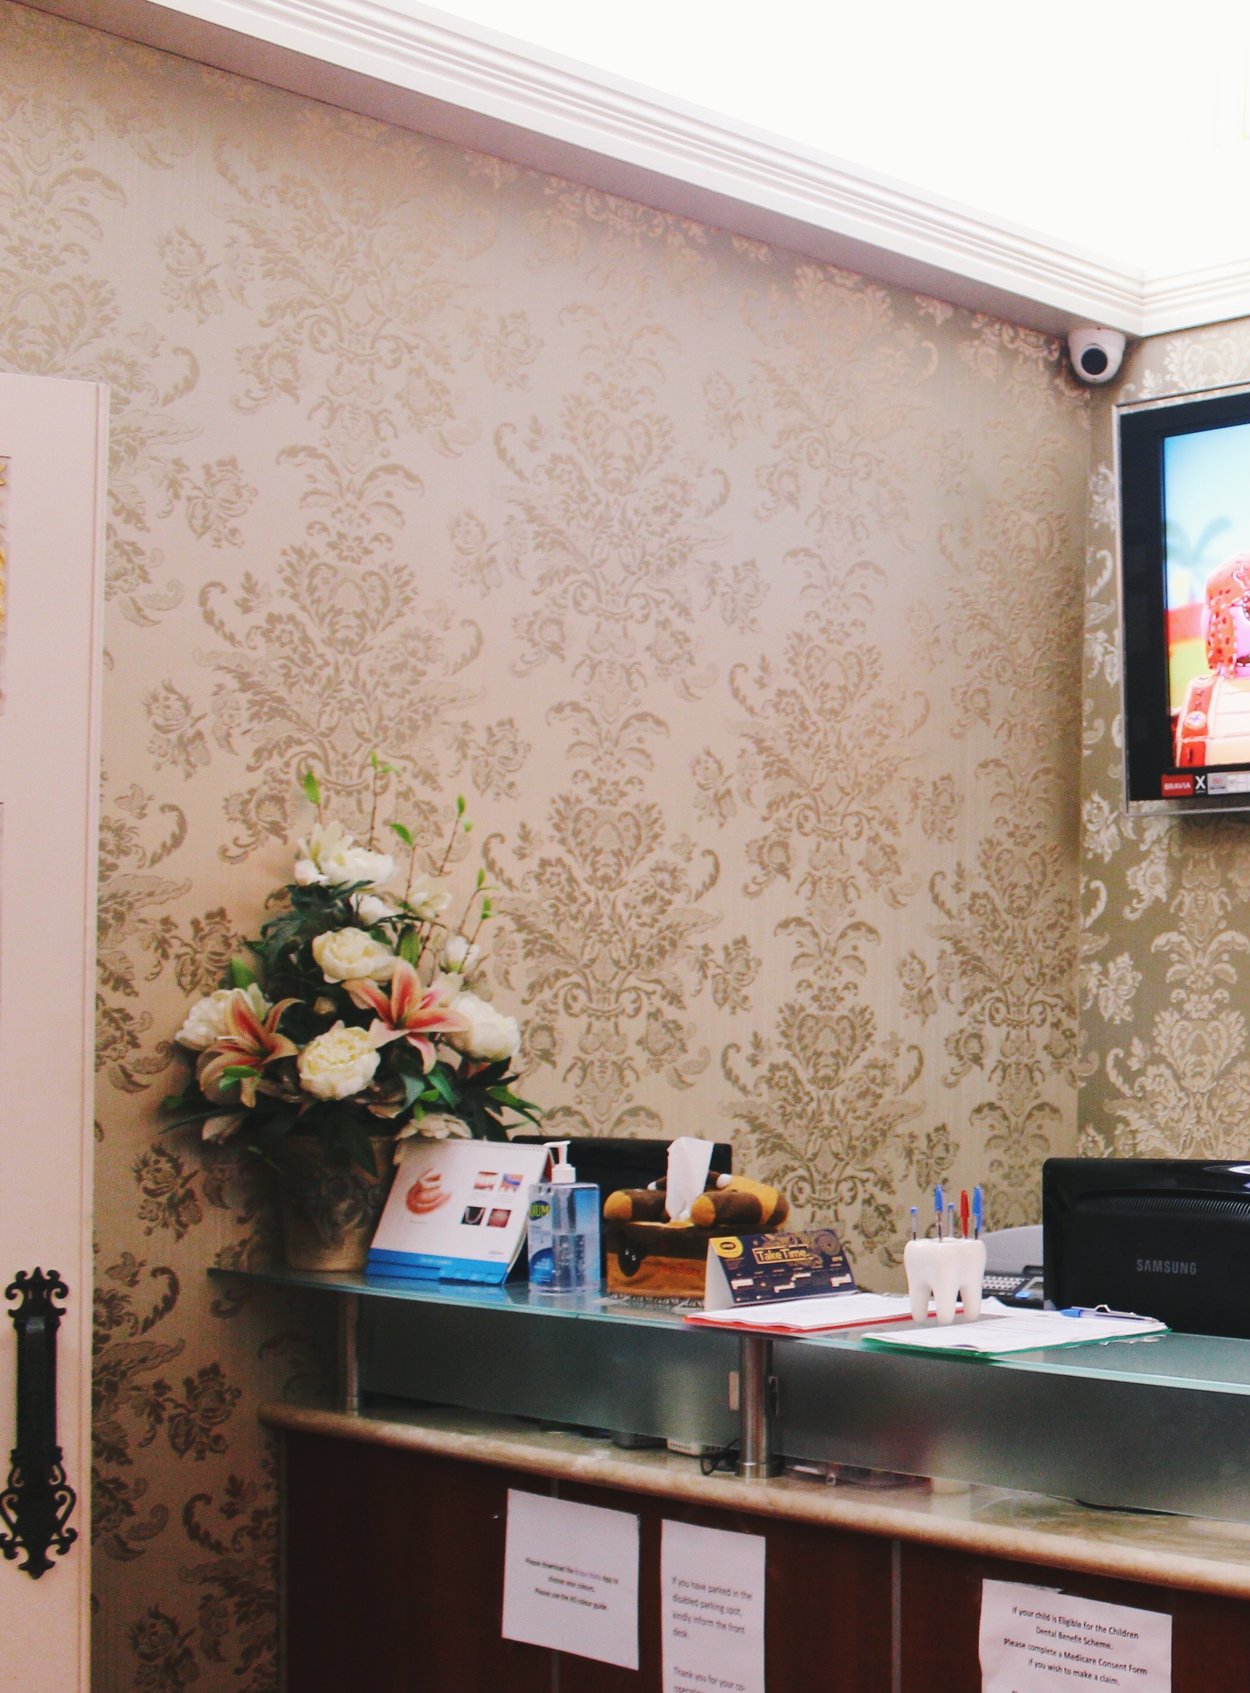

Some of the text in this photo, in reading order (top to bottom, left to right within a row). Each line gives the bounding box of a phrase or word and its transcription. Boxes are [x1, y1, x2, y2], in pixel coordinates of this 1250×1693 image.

[1164, 782, 1191, 791] BRAVIA
[759, 1250, 782, 1262] Take
[1136, 1259, 1197, 1275] SAMSUNG
[690, 1581, 706, 1592] have
[707, 1584, 731, 1598] parked
[740, 1589, 752, 1601] the
[700, 1600, 725, 1615] parking
[673, 1611, 745, 1635] kindly inform the front
[1019, 1609, 1034, 1618] your
[1035, 1611, 1051, 1622] child
[1052, 1614, 1058, 1623] is
[1058, 1616, 1082, 1629] Eligible
[1083, 1620, 1094, 1632] for
[1095, 1624, 1107, 1634] the
[1108, 1626, 1139, 1640] Children
[1036, 1626, 1057, 1638] Dental
[1058, 1631, 1082, 1644] Benefit
[1003, 1637, 1026, 1648] Please
[1027, 1643, 1057, 1656] complete
[1063, 1650, 1097, 1665] Medicare
[1098, 1658, 1128, 1673] Consent
[1128, 1664, 1147, 1677] Form
[674, 1666, 694, 1680] Thank
[694, 1674, 707, 1684] you
[708, 1674, 718, 1686] for
[719, 1679, 735, 1690] your
[1034, 1661, 1046, 1670] you
[1047, 1664, 1063, 1675] wish
[1064, 1667, 1072, 1677] to
[1072, 1669, 1093, 1680] make
